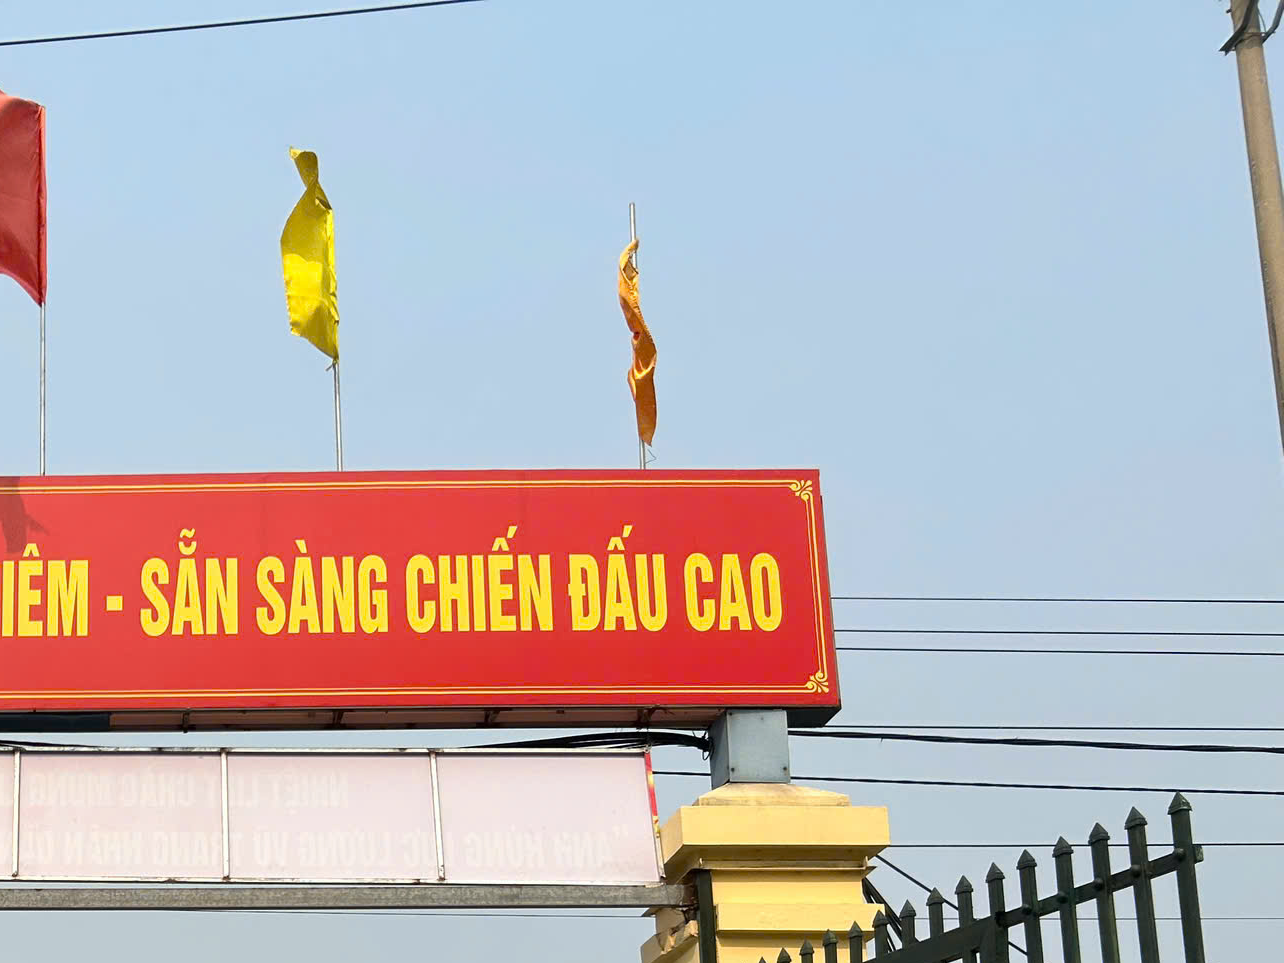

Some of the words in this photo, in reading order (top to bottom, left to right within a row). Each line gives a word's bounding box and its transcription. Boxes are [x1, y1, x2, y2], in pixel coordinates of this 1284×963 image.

[140, 529, 239, 637] SẴN
[256, 540, 388, 636] SÀNG
[406, 526, 554, 633] CHIẾN
[569, 526, 668, 633] ĐẤU
[684, 552, 782, 633] CAO
